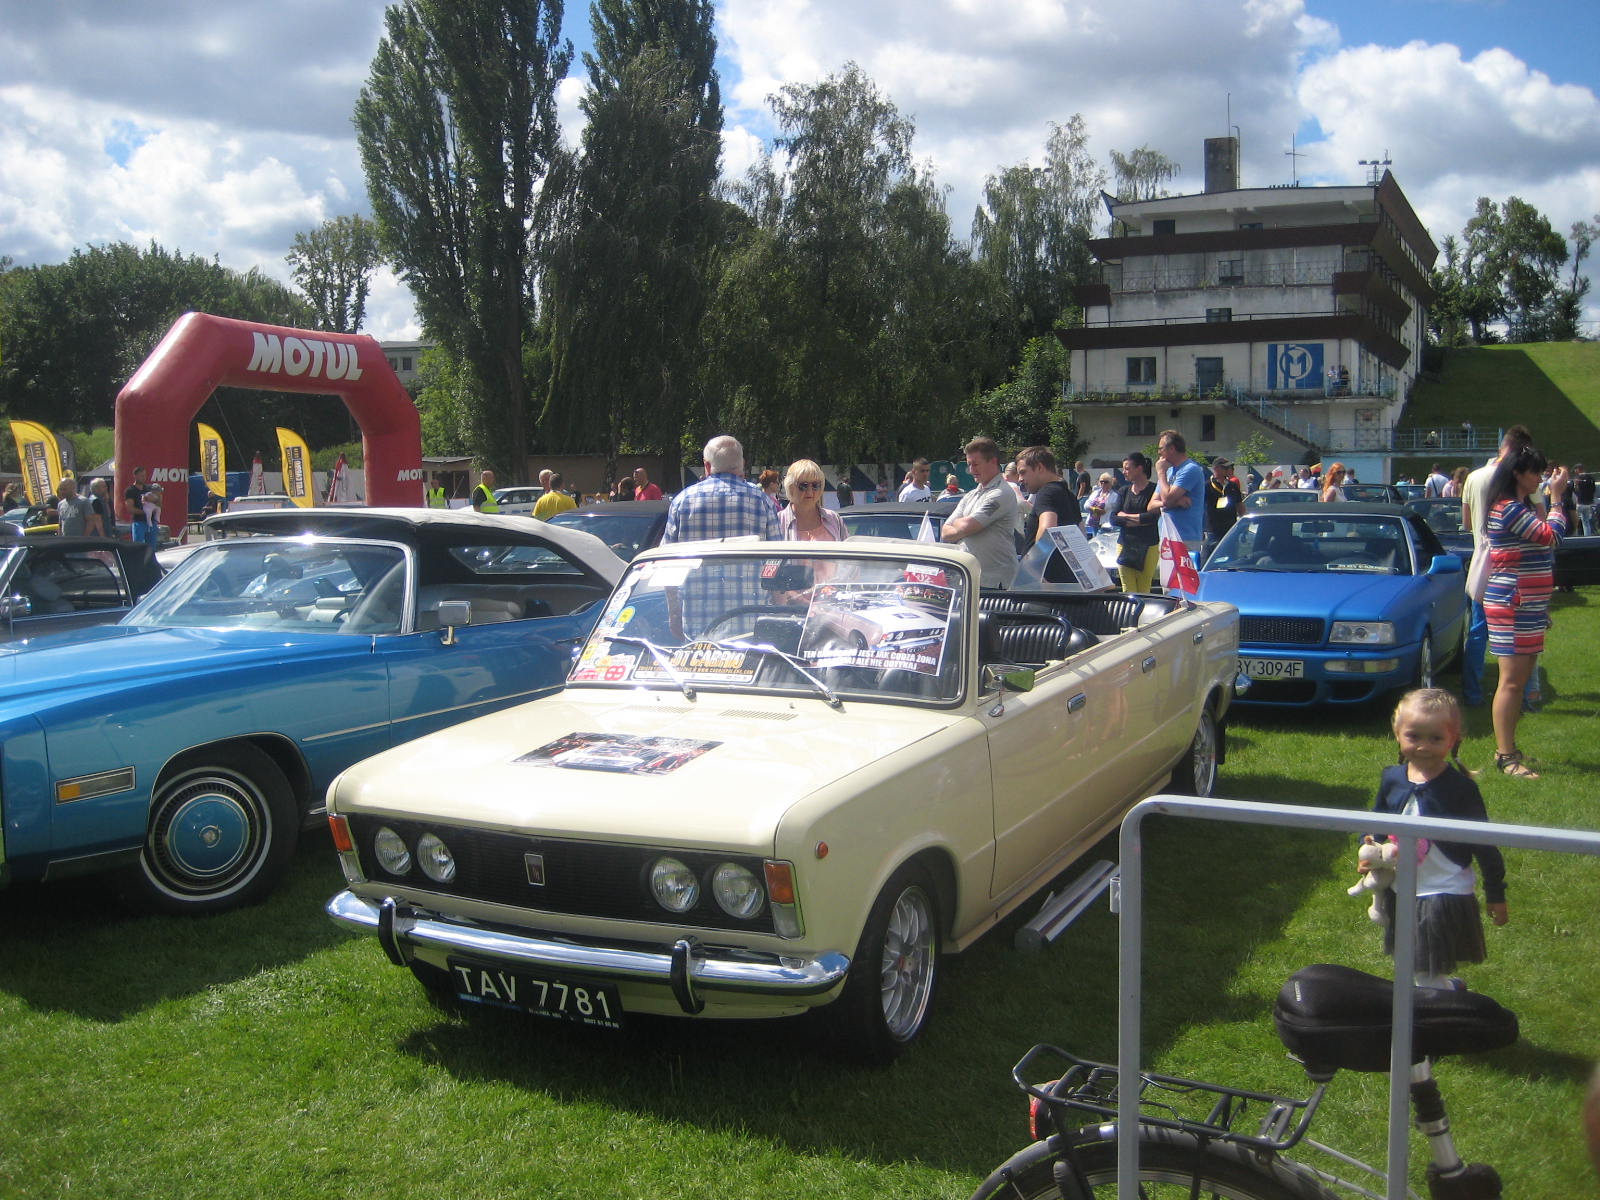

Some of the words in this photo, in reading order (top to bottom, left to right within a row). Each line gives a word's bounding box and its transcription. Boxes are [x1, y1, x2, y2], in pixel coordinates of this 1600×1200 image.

[246, 332, 363, 381] MOTUL
[1257, 661, 1302, 677] 3094F
[454, 965, 516, 1003] TAV
[532, 980, 611, 1019] 7781
